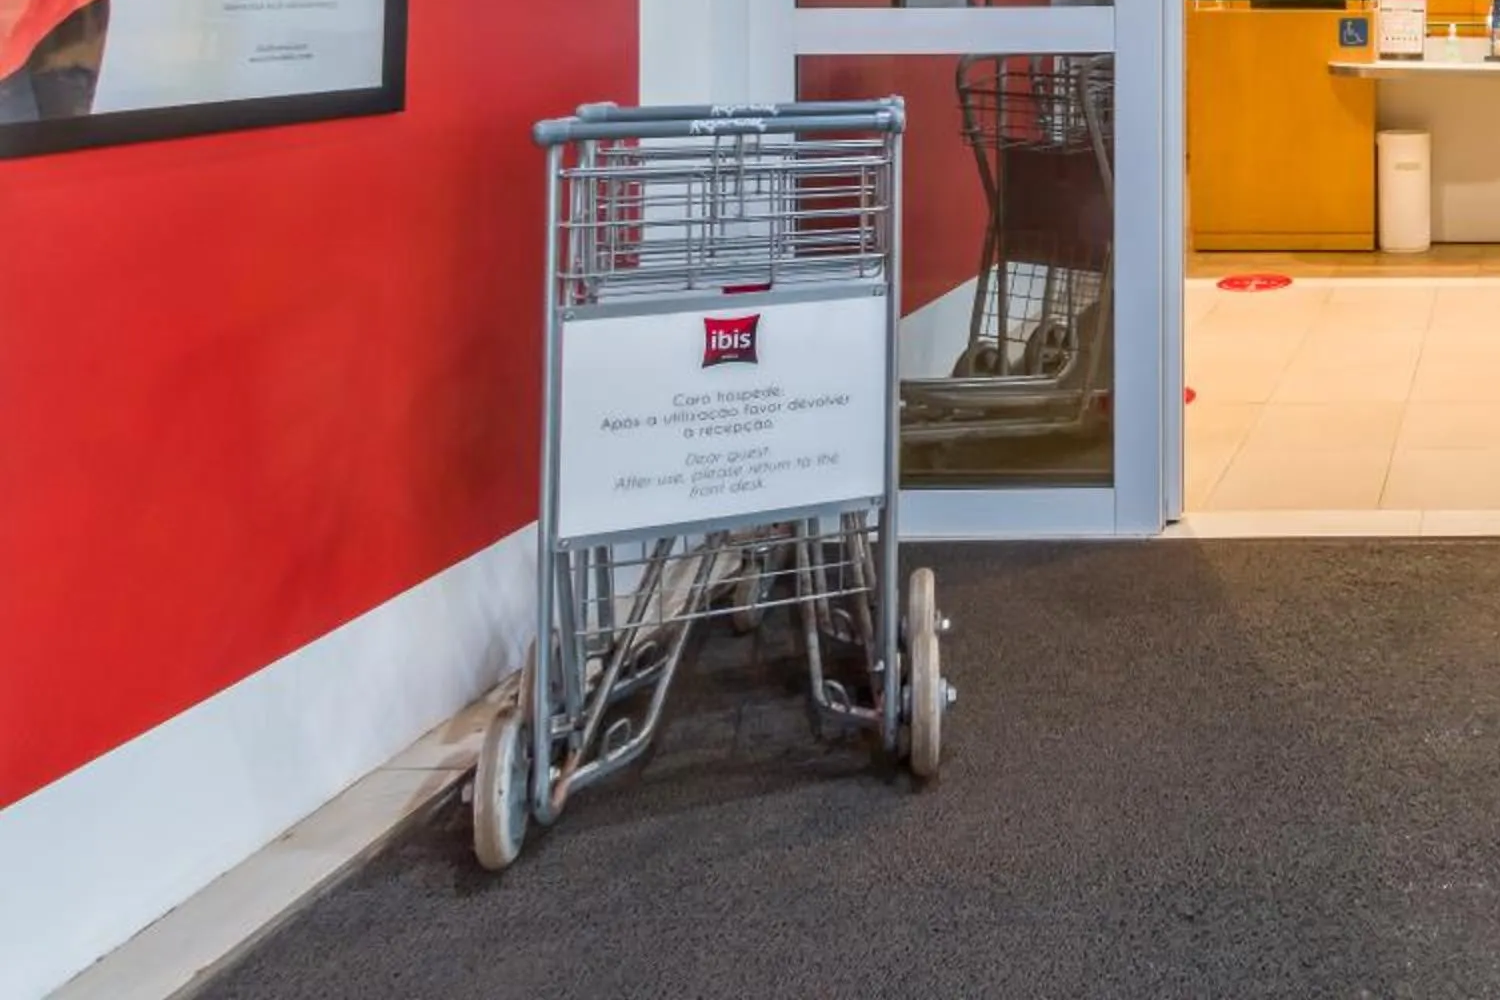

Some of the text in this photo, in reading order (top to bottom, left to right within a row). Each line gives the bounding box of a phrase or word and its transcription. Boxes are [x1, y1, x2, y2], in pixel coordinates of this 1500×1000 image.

[711, 328, 751, 350] ibis
[646, 416, 657, 427] a
[744, 401, 782, 416] favor
[787, 394, 850, 411] devolver
[672, 393, 711, 407] Caro
